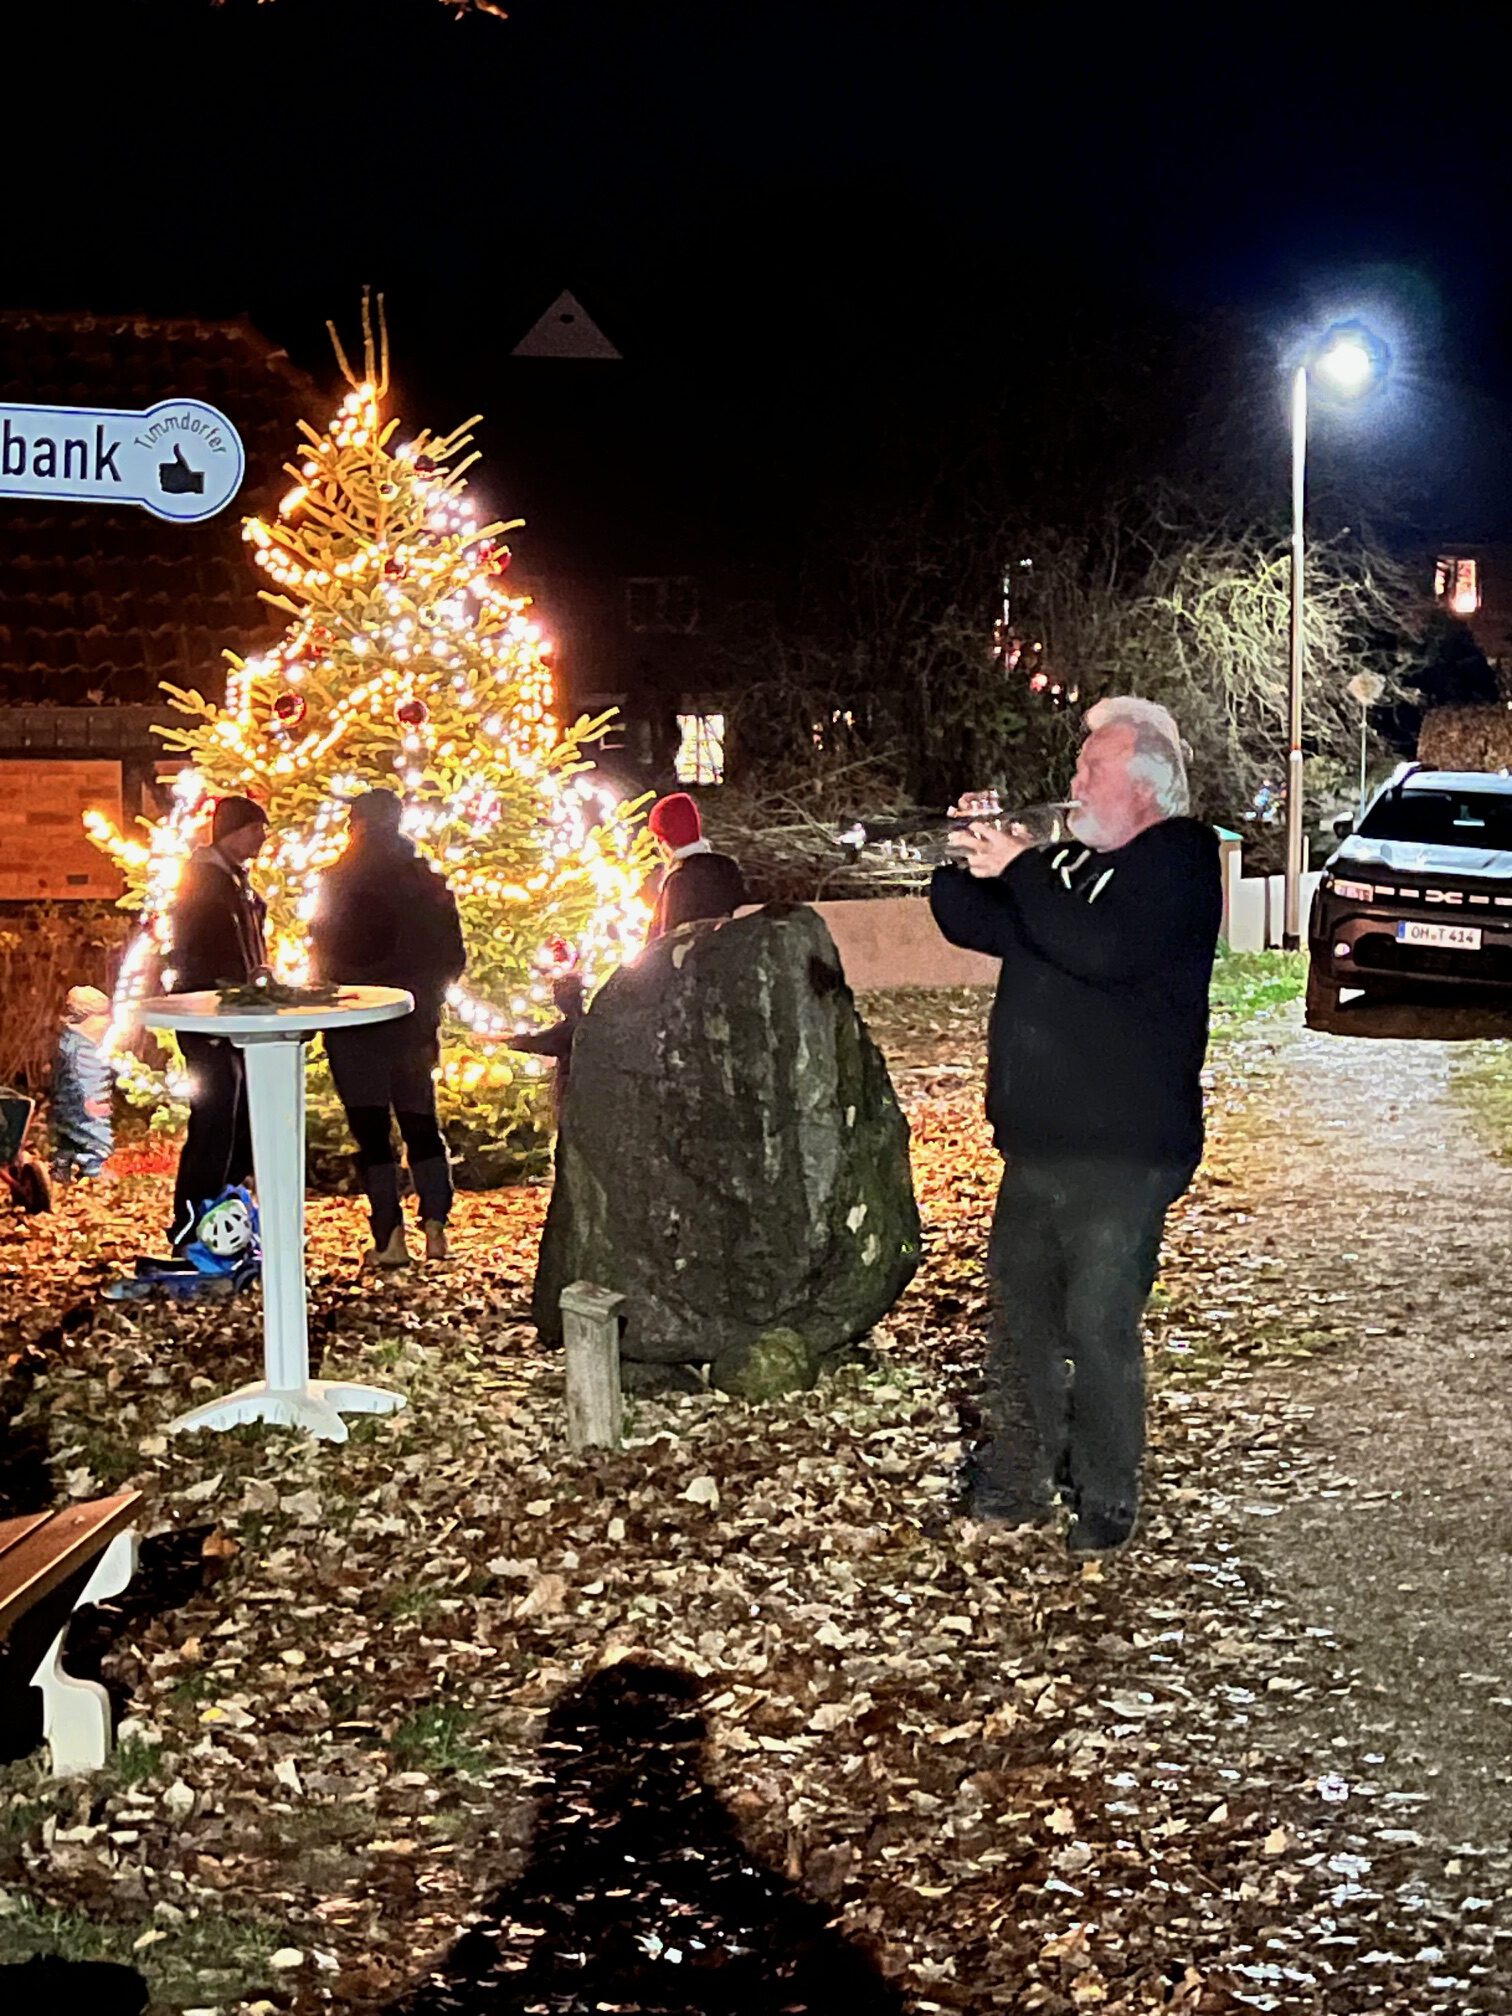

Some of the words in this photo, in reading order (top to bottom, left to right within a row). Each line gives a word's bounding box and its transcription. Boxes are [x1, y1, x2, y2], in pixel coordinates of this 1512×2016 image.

[2, 419, 122, 482] bank
[134, 411, 226, 455] Timmdorfer
[1410, 926, 1430, 939] OH
[1438, 928, 1446, 940] T
